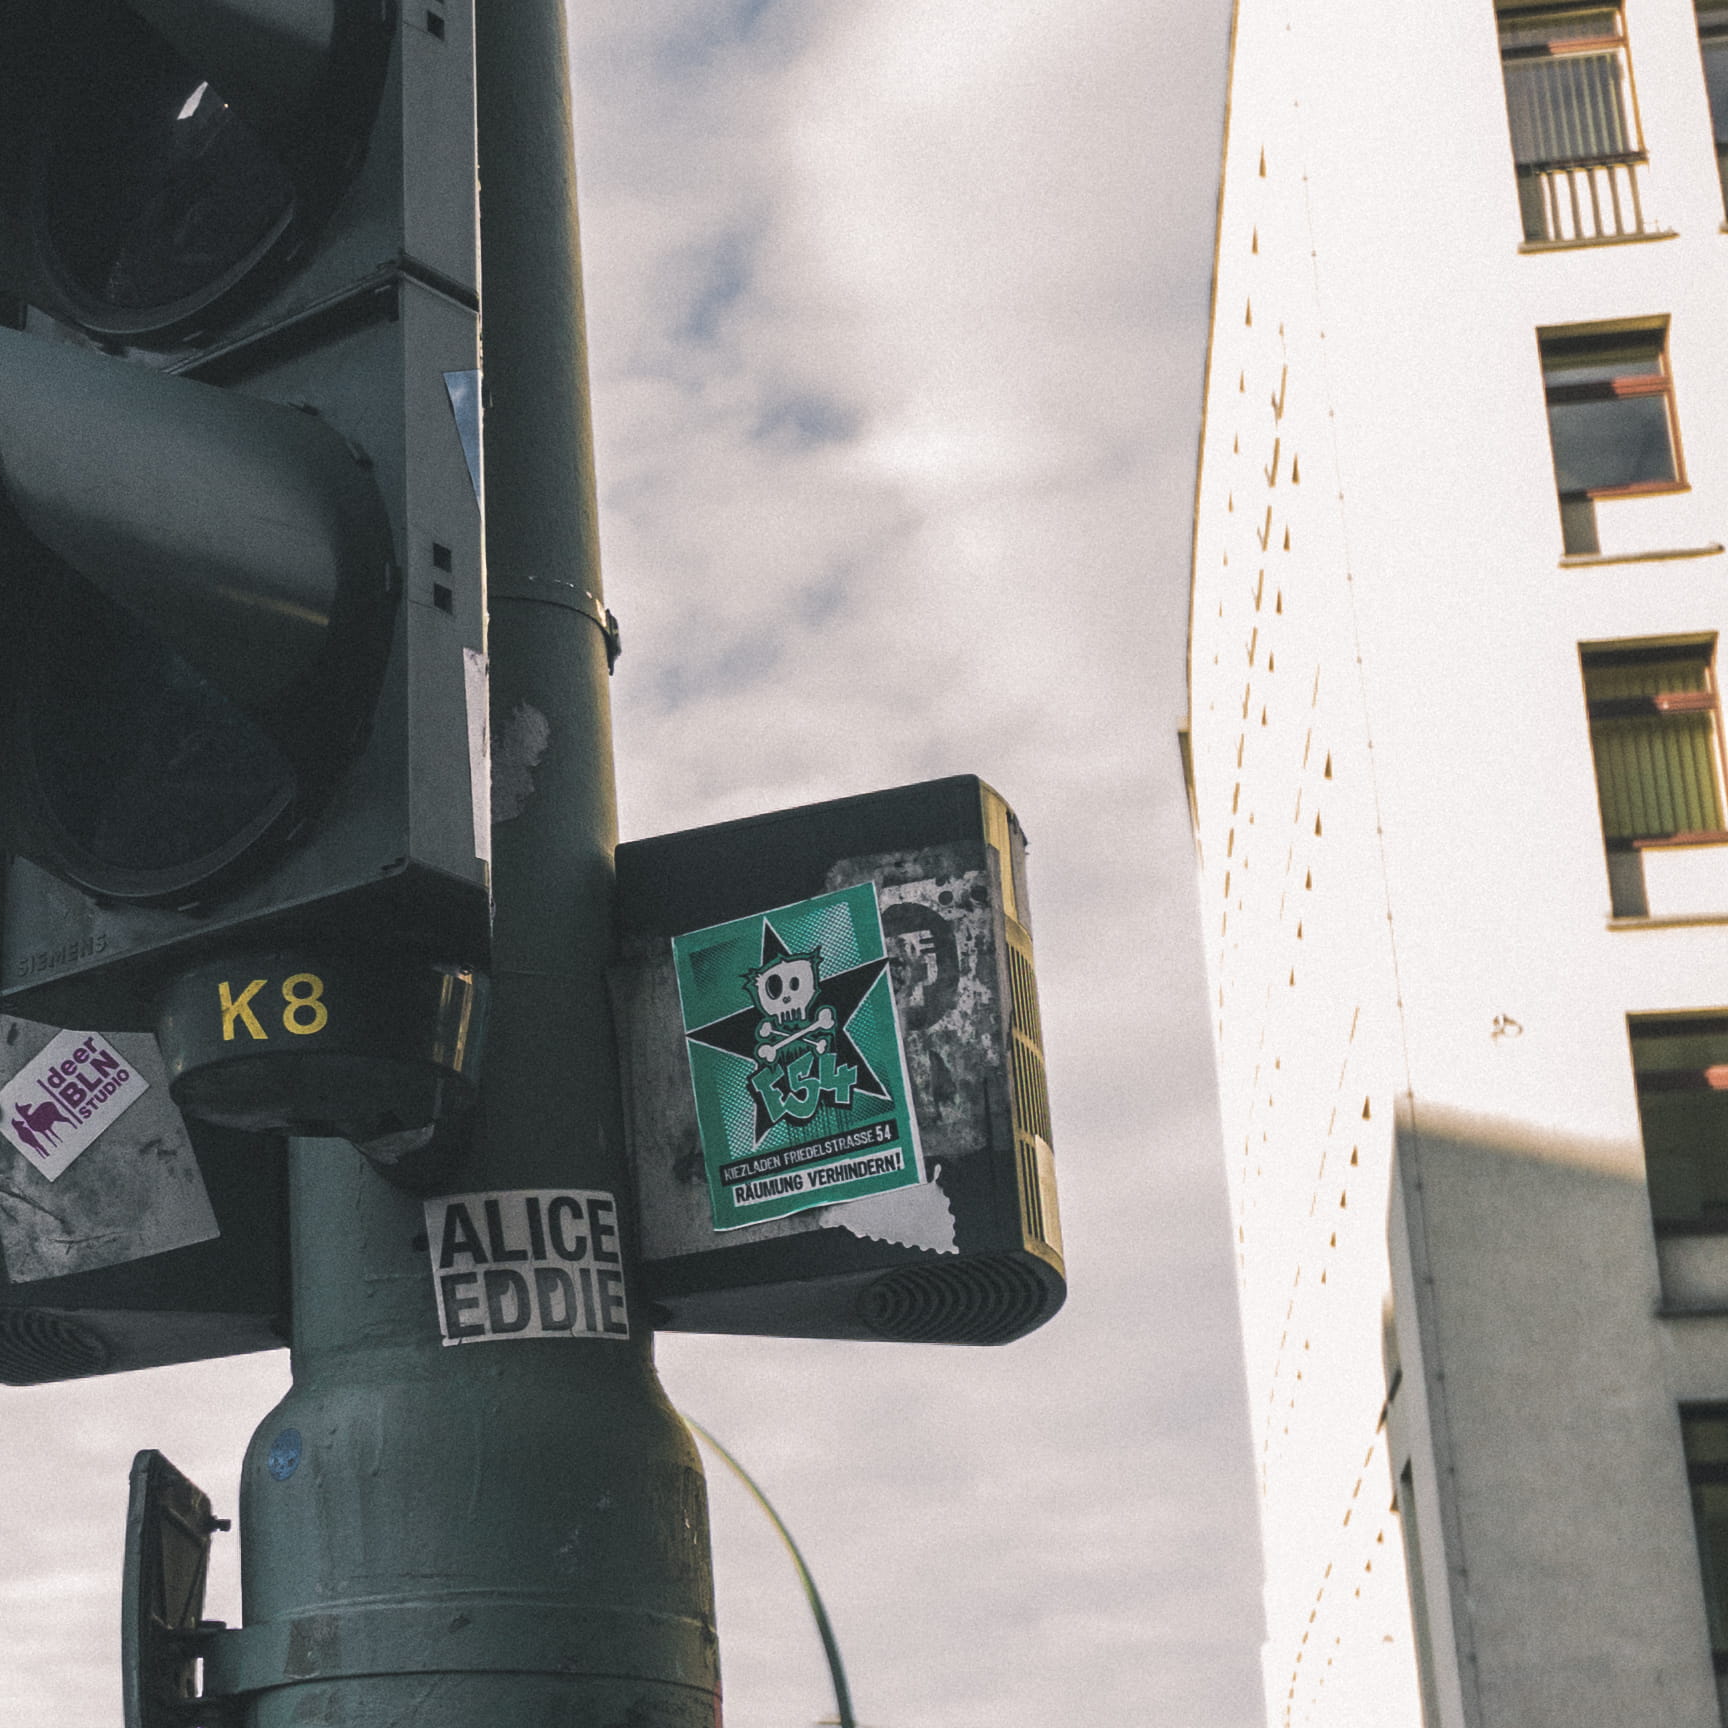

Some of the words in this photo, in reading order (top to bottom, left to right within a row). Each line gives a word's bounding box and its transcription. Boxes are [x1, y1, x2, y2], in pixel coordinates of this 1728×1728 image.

[19, 933, 108, 978] SIEMENS
[47, 1036, 98, 1089] deer
[58, 1049, 121, 1109] BLN
[78, 1068, 130, 1119] STUDIO
[723, 1156, 782, 1182] KIEZLADEN
[783, 1129, 875, 1165] FRIEDELSTRASSE
[875, 1123, 893, 1143] 54
[734, 1174, 804, 1204] RÄUMUNG
[806, 1151, 903, 1189] VERHINDERN!
[438, 1195, 620, 1269] ALICE
[438, 1267, 628, 1341] EDDIE
